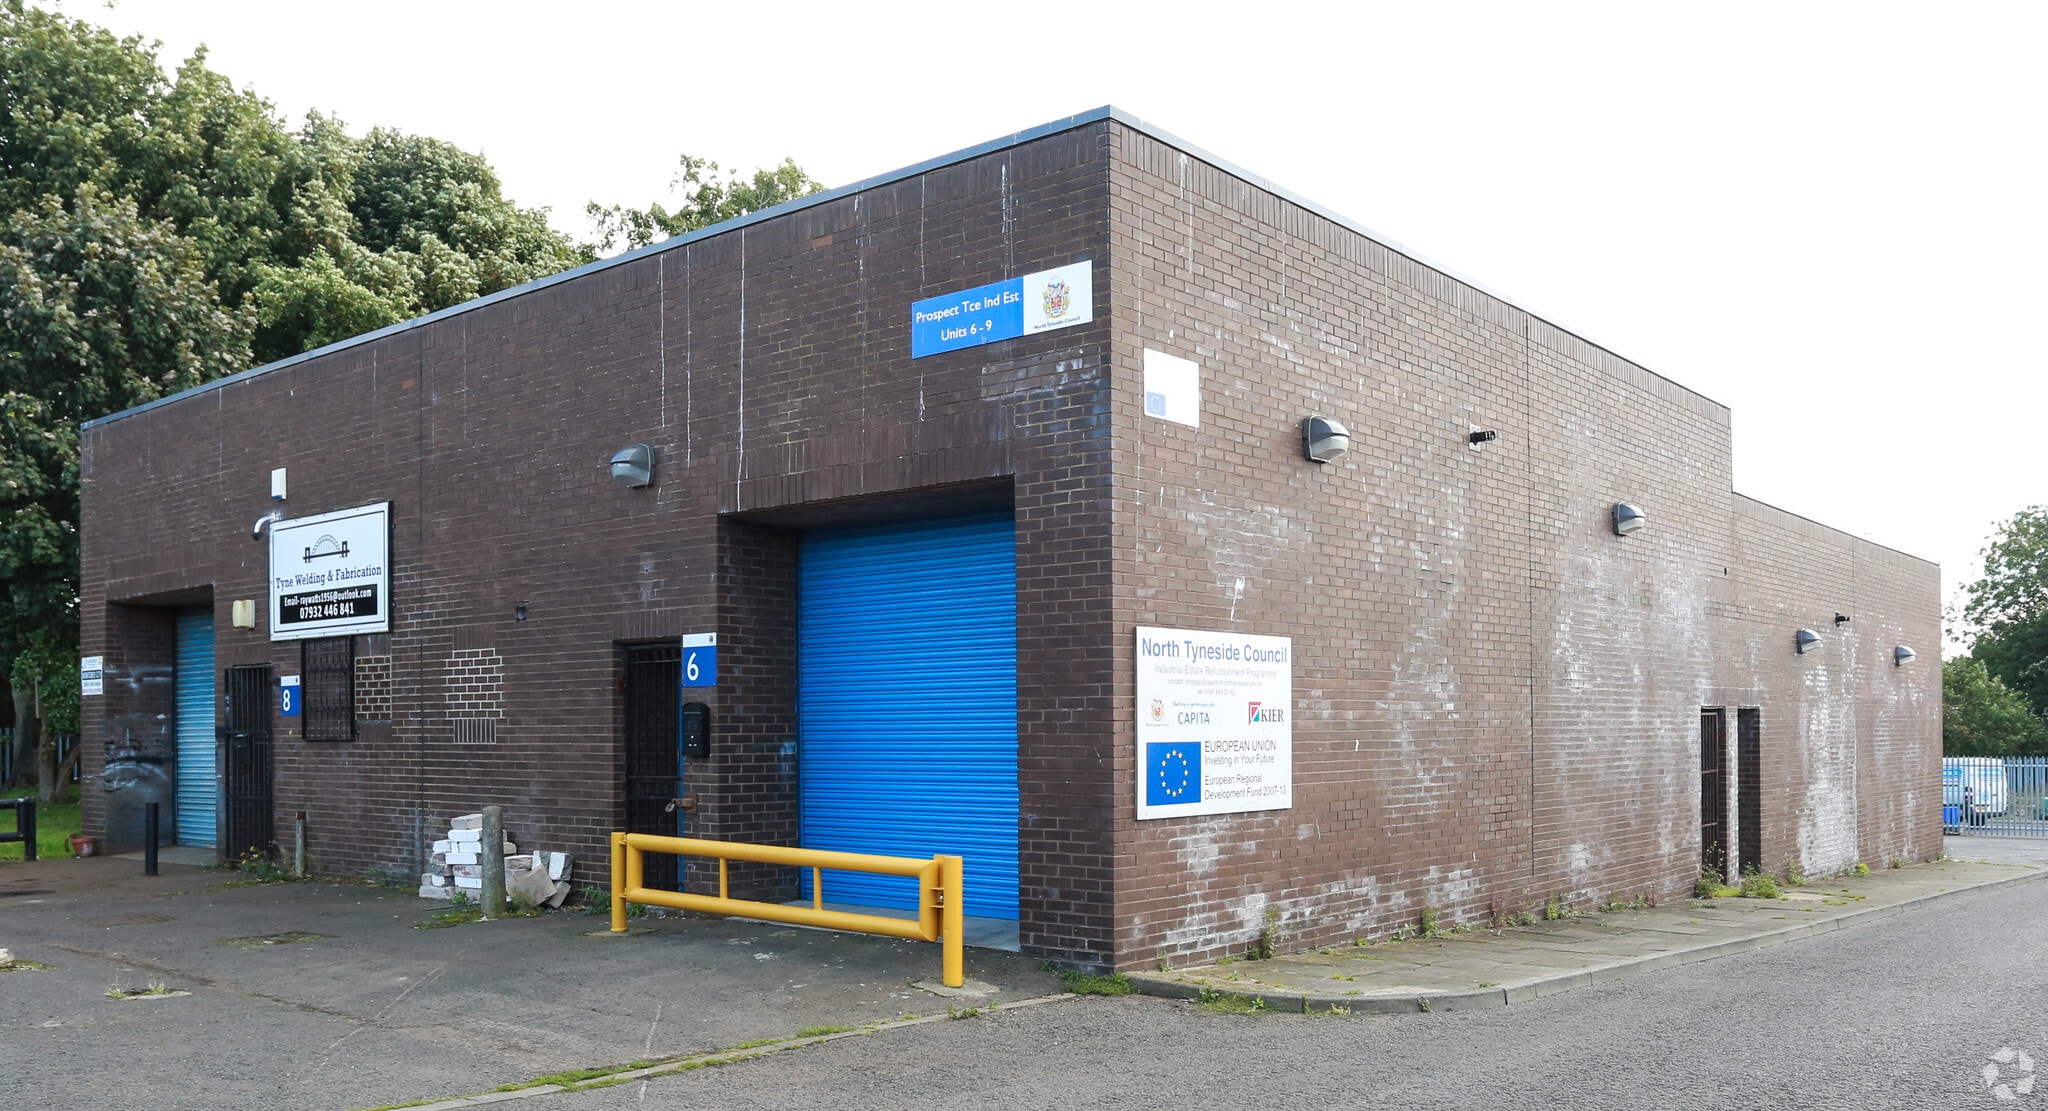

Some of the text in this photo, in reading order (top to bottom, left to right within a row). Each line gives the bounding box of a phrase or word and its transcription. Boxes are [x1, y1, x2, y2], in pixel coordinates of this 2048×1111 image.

[916, 291, 1020, 324] Prospect Tce Ind Est
[1065, 315, 1081, 324] Council
[941, 328, 967, 341] Units
[970, 323, 977, 334] 6
[986, 320, 992, 332] 9
[276, 565, 382, 591] Tyne Welding & Fabrication
[300, 602, 354, 619] 07932 446 841
[1142, 638, 1287, 663] North Tyneside Council
[687, 652, 699, 681] 6
[1155, 664, 1277, 679] Industrial Estate Refurbishment Programme
[283, 689, 290, 712] 8
[1177, 712, 1210, 725] CAPITA
[1261, 709, 1284, 722] KIER
[1205, 739, 1276, 752] EUROPEAN UNION
[1205, 753, 1275, 767] Investing in Your Future
[1205, 773, 1262, 786] European Regional
[1205, 785, 1287, 800] Development Fund 2007-13
